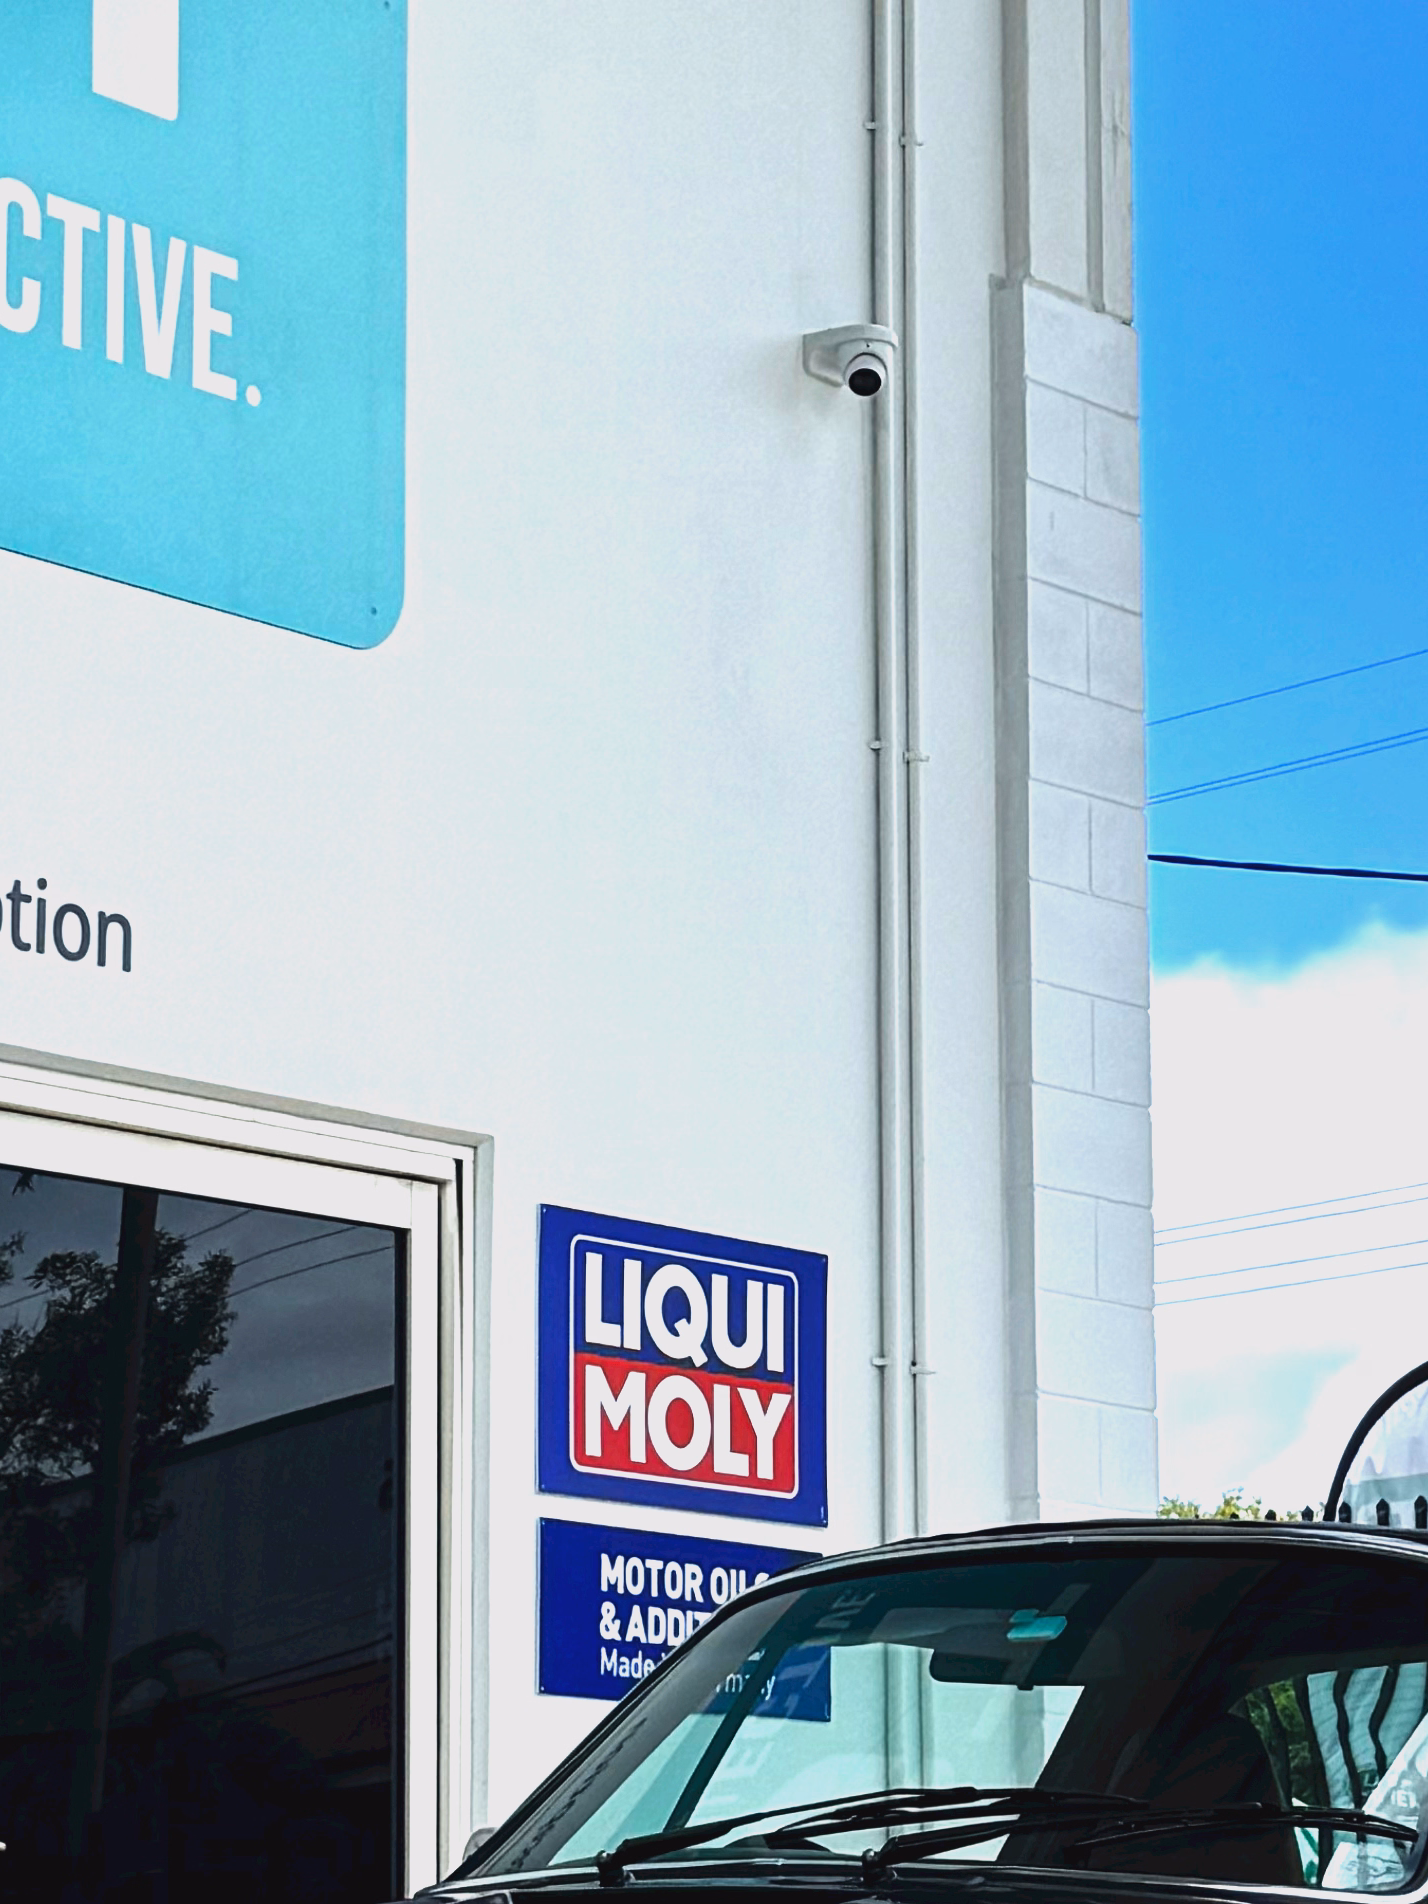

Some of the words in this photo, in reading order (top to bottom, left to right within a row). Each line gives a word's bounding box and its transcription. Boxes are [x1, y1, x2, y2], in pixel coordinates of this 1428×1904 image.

[585, 1251, 785, 1373] LIQUI
[585, 1364, 791, 1481] MOLY
[600, 1553, 704, 1603] MOTOR
[599, 1601, 622, 1642] &
[600, 1646, 657, 1678] Made
